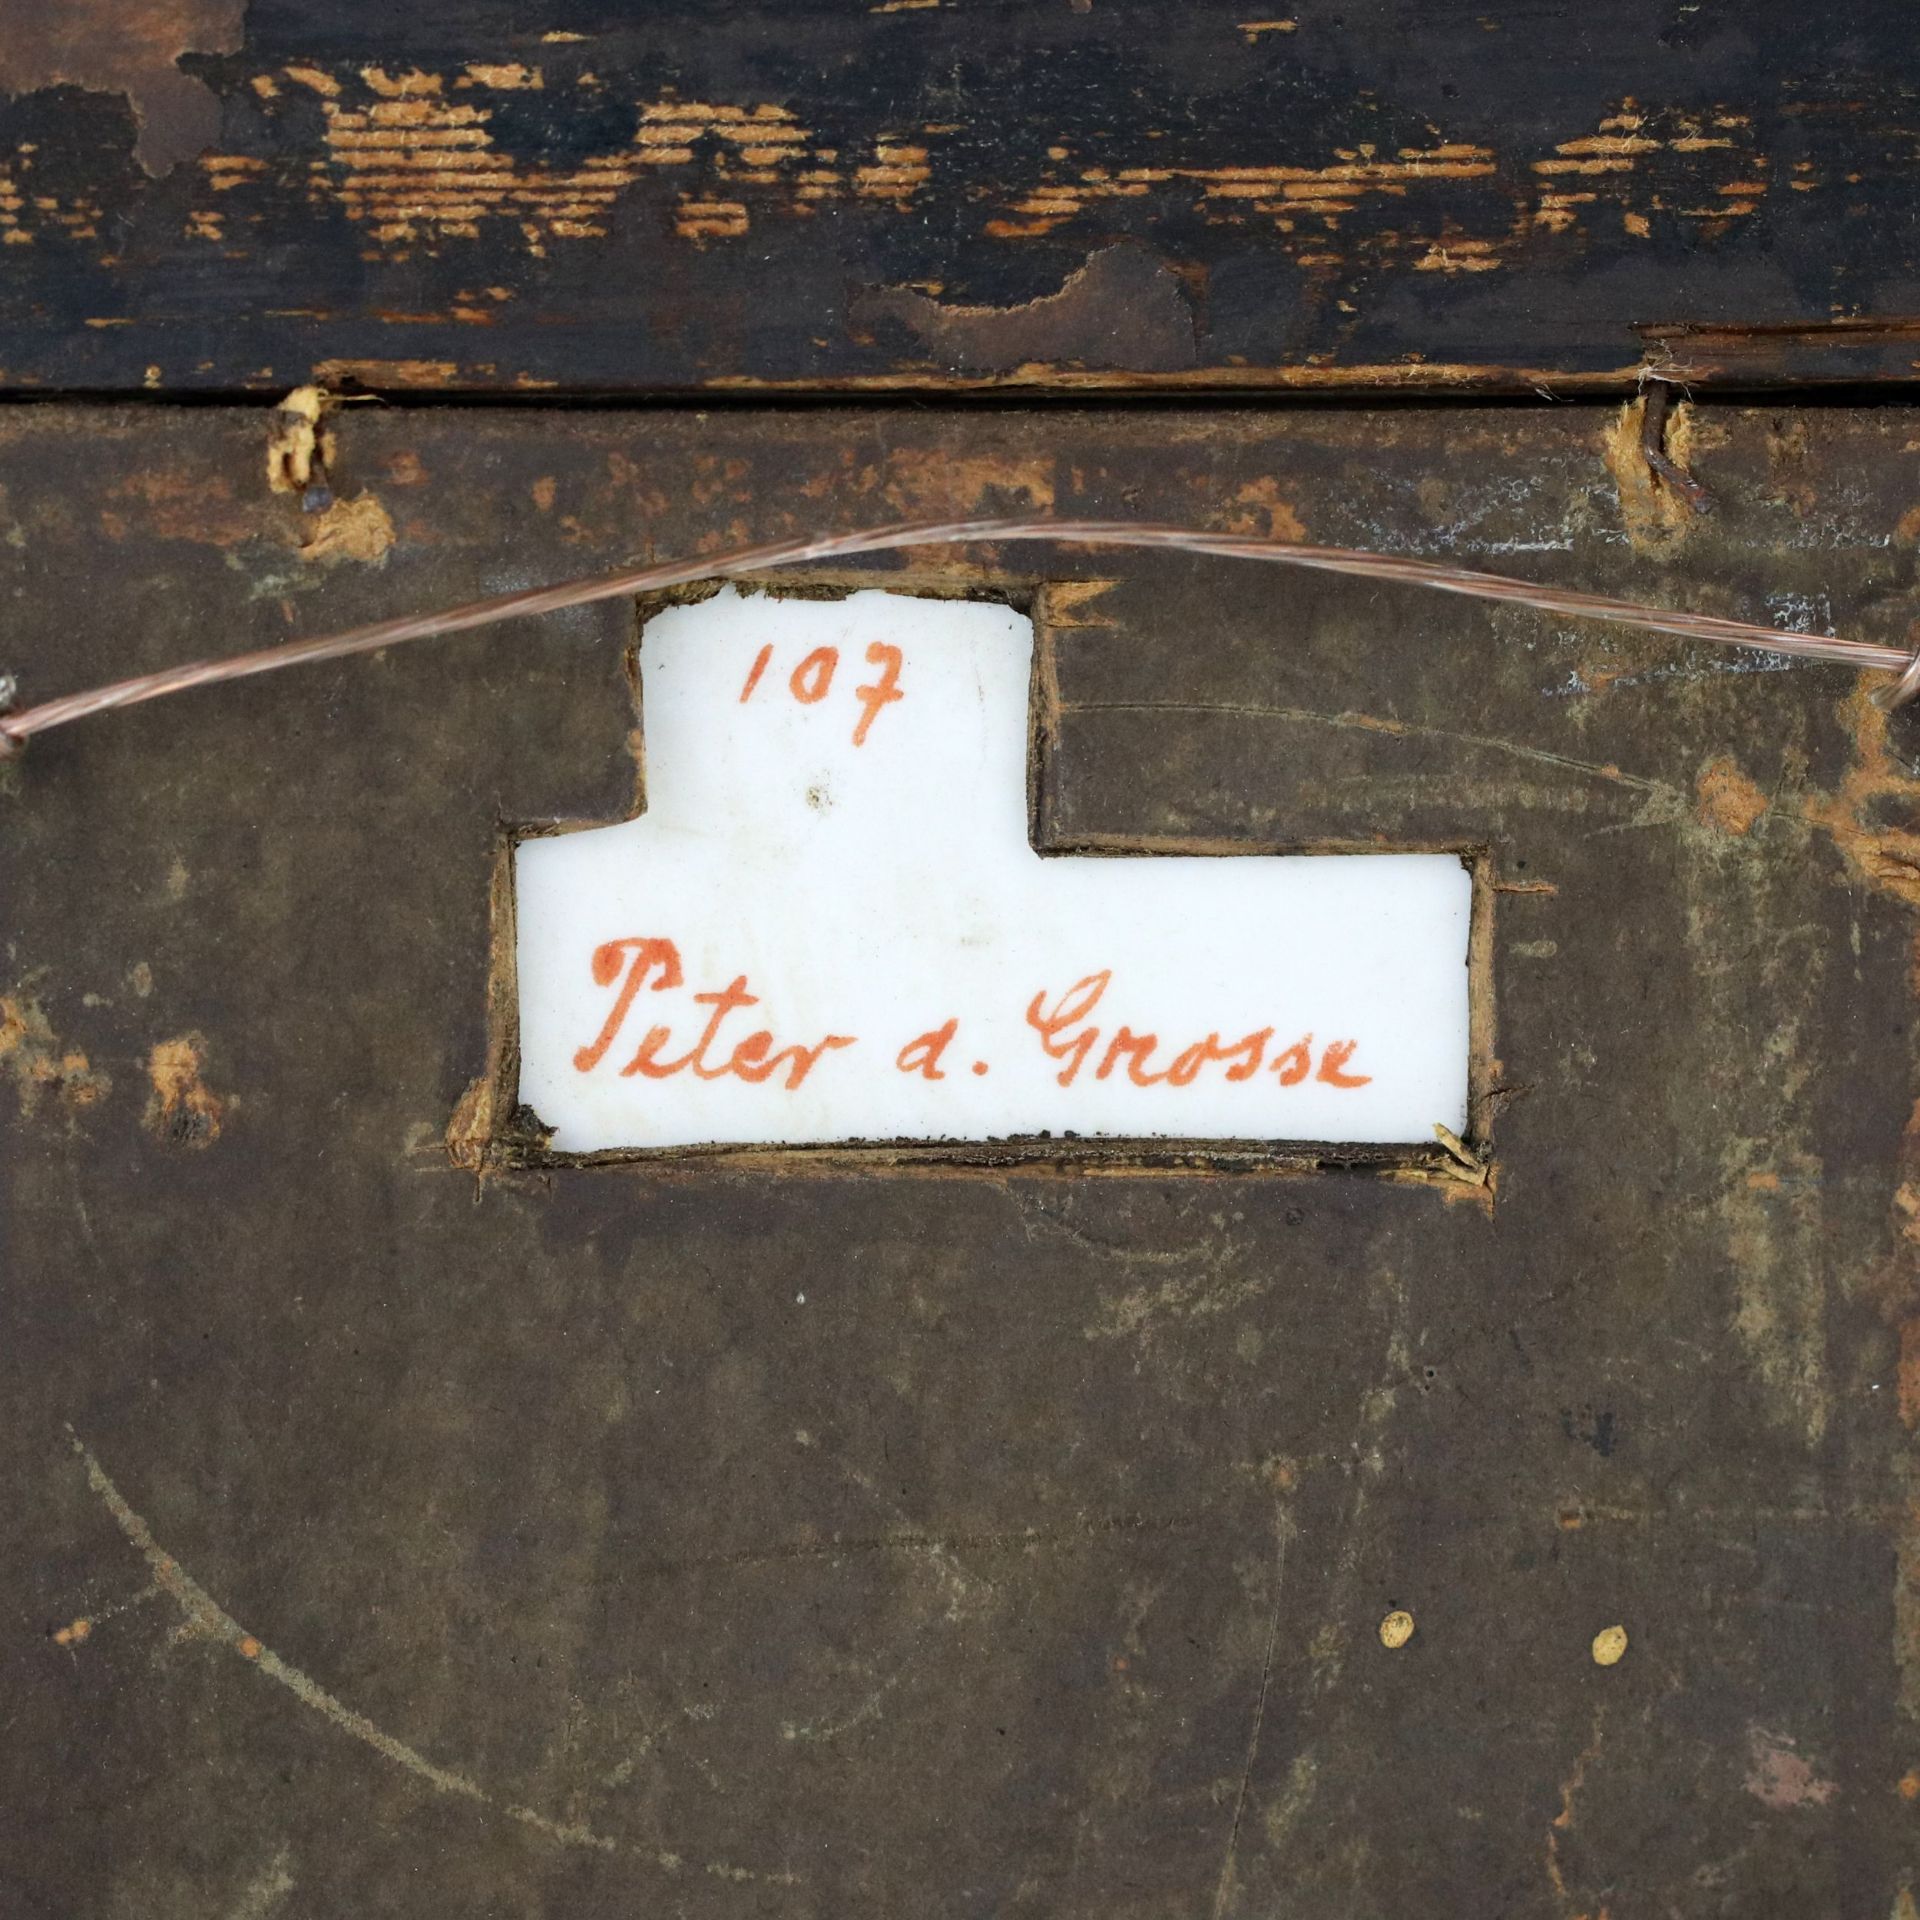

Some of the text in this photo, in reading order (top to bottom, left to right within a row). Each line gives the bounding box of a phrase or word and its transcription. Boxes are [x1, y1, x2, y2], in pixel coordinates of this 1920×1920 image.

[740, 642, 904, 748] 107
[573, 937, 1373, 1090] Peter d. Grosse
